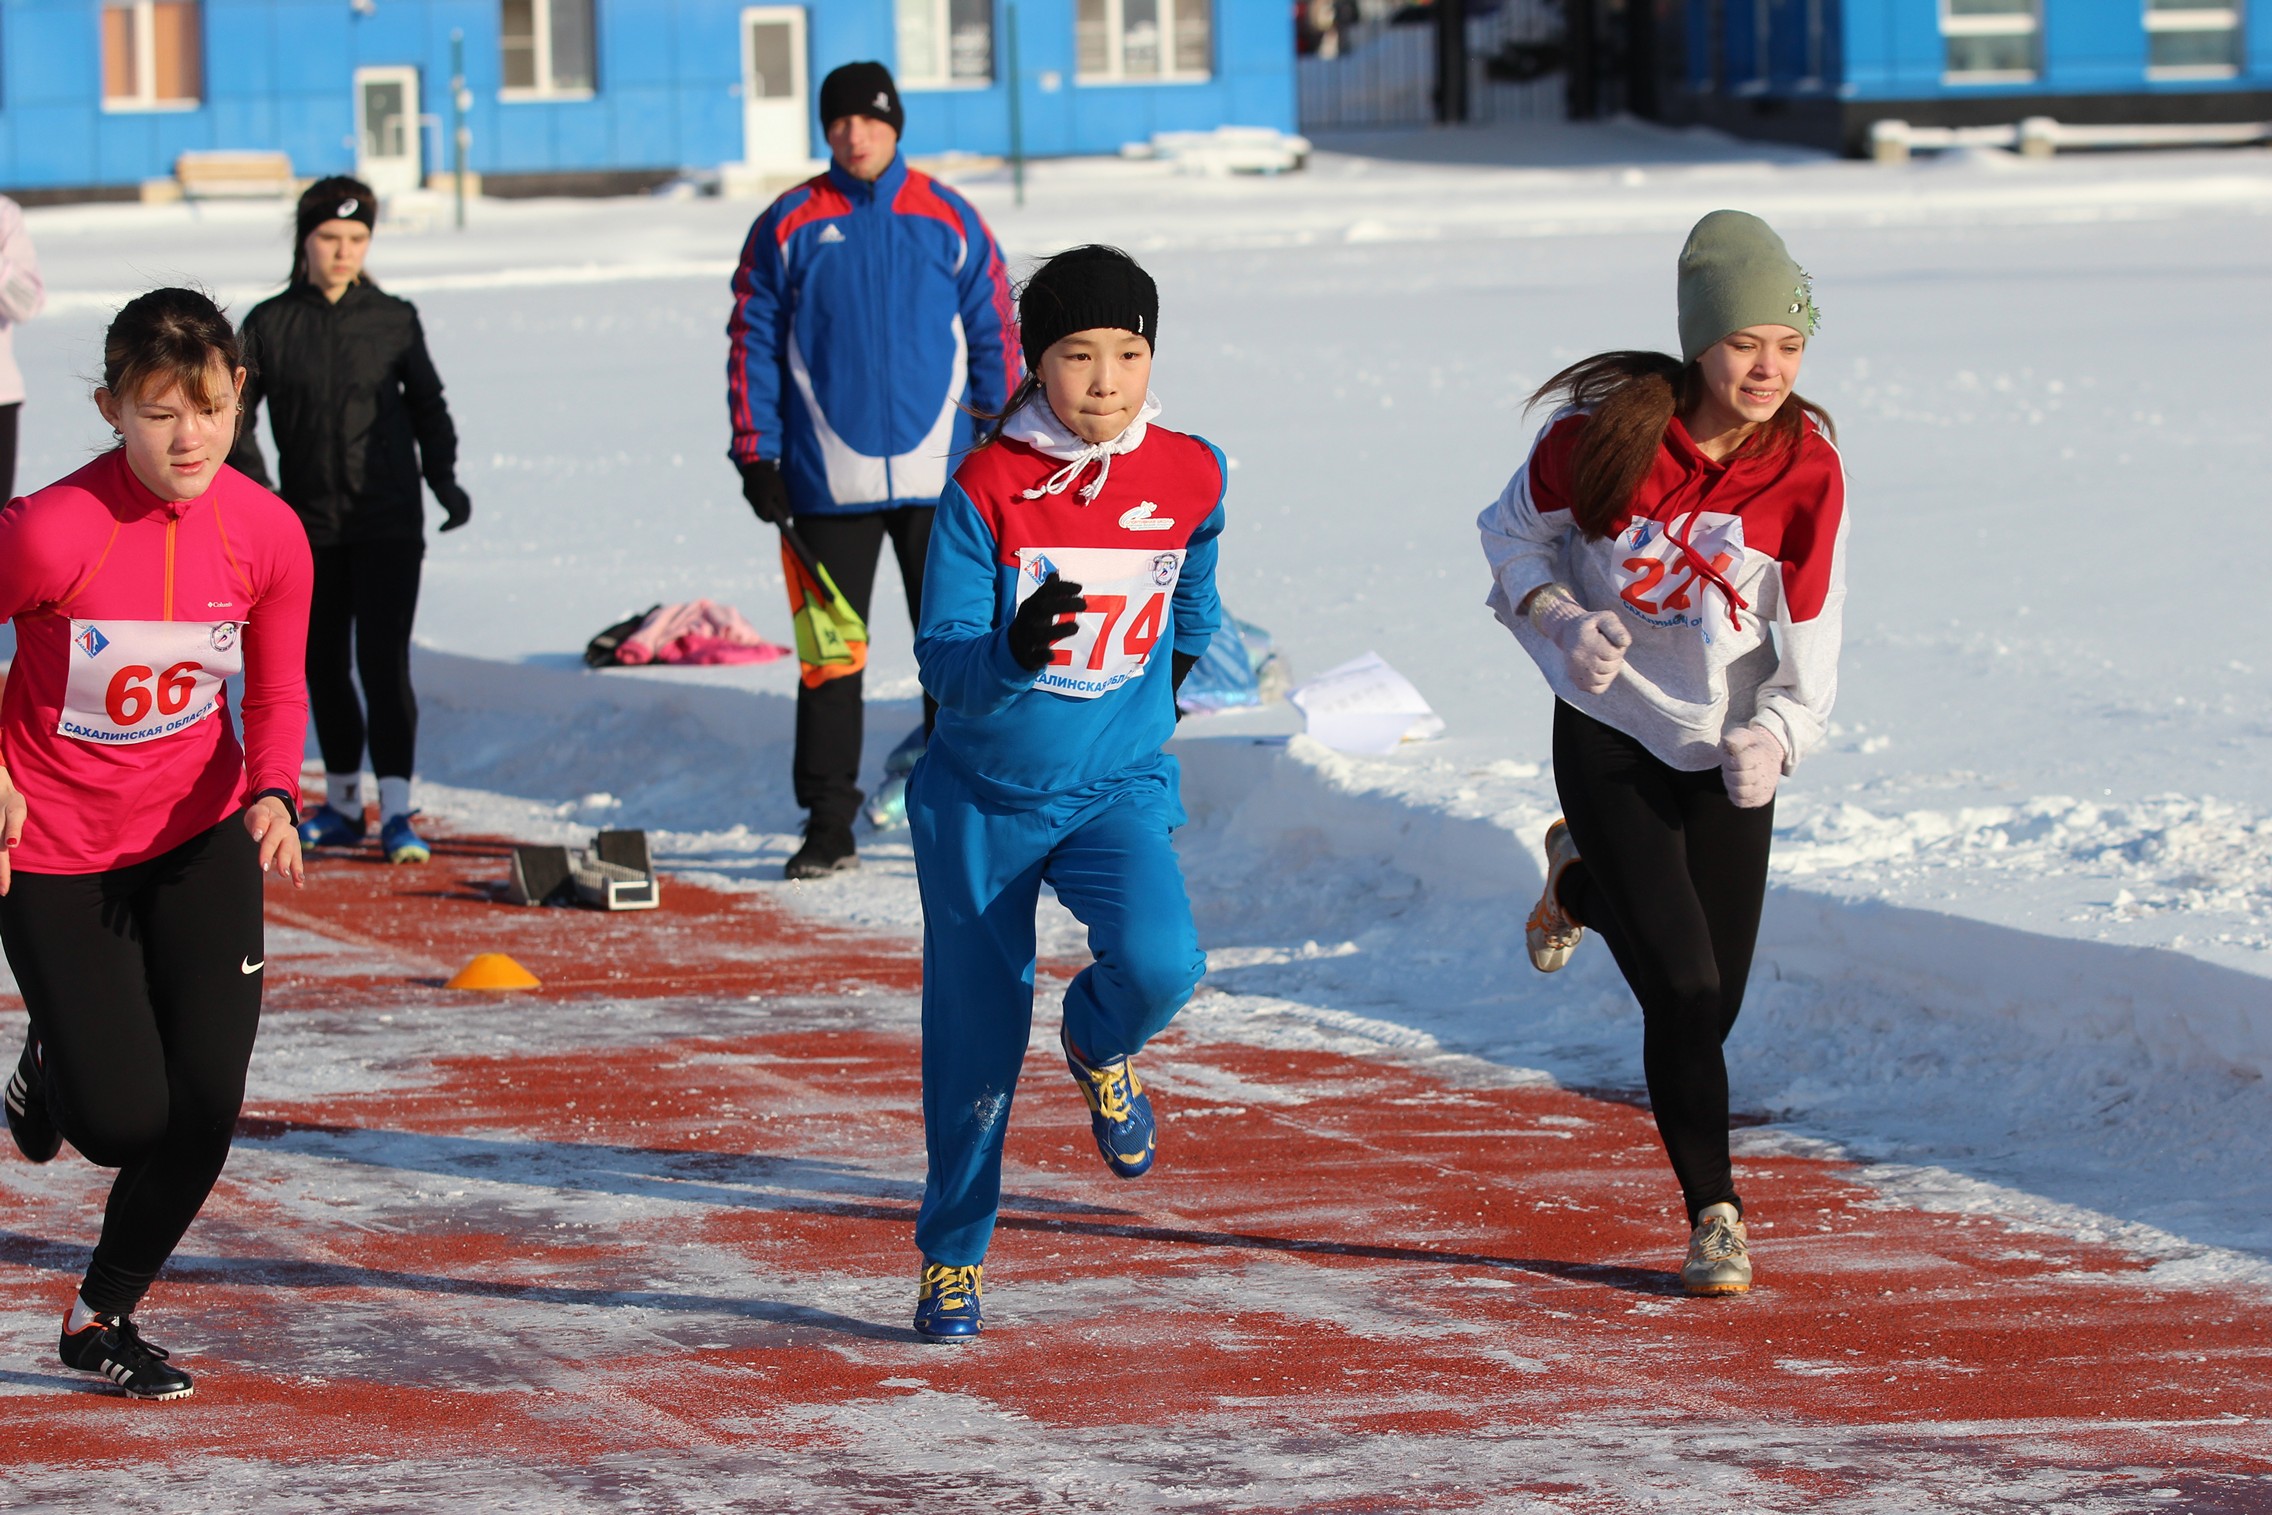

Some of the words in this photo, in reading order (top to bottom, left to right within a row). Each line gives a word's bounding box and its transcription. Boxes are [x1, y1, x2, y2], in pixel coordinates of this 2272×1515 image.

[105, 661, 203, 726] 66
[63, 722, 163, 741] САХАЛИНСКАЯ
[165, 701, 213, 731] ОБЛАСТЬ
